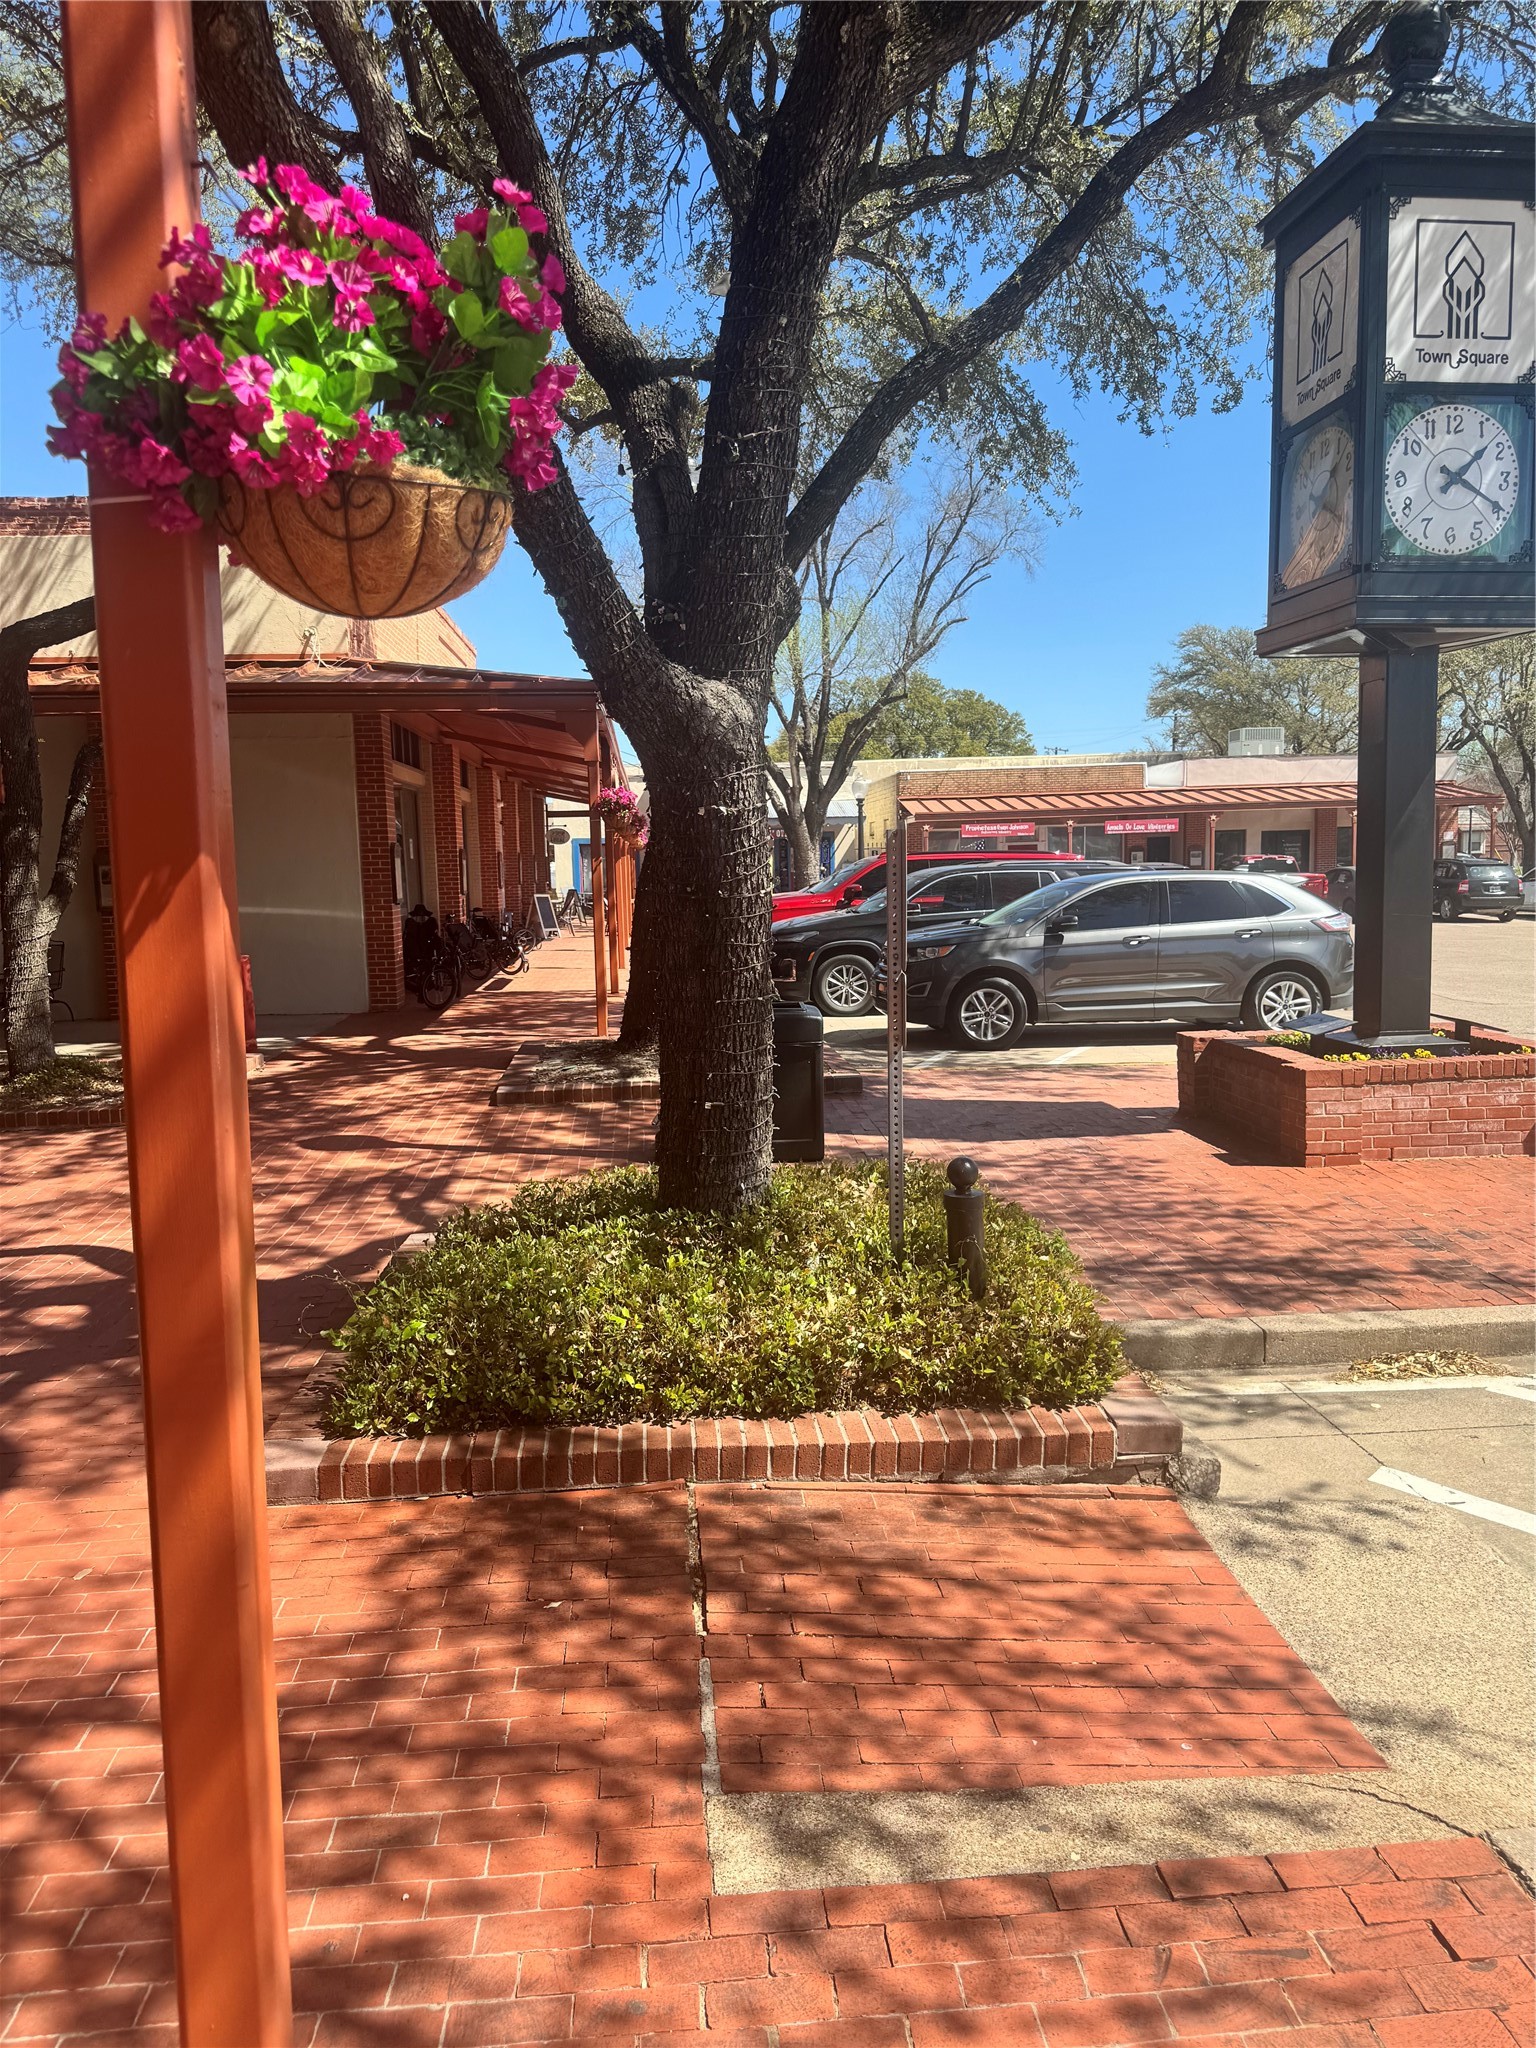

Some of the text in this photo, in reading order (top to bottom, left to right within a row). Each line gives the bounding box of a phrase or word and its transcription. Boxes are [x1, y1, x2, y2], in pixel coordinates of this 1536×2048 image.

[1415, 348, 1509, 368] Town Square
[1297, 369, 1341, 406] Town Square
[1424, 418, 1437, 440] 11
[1446, 414, 1464, 435] 12
[1478, 420, 1484, 439] 1
[1320, 438, 1330, 461] 12
[1402, 436, 1422, 457] 10
[1495, 441, 1505, 461] 2
[1394, 470, 1407, 488] 9
[1498, 471, 1511, 492] 3
[1401, 496, 1412, 518] 8
[1420, 516, 1434, 540] 7
[1444, 526, 1456, 545] 6
[1469, 521, 1484, 542] 5
